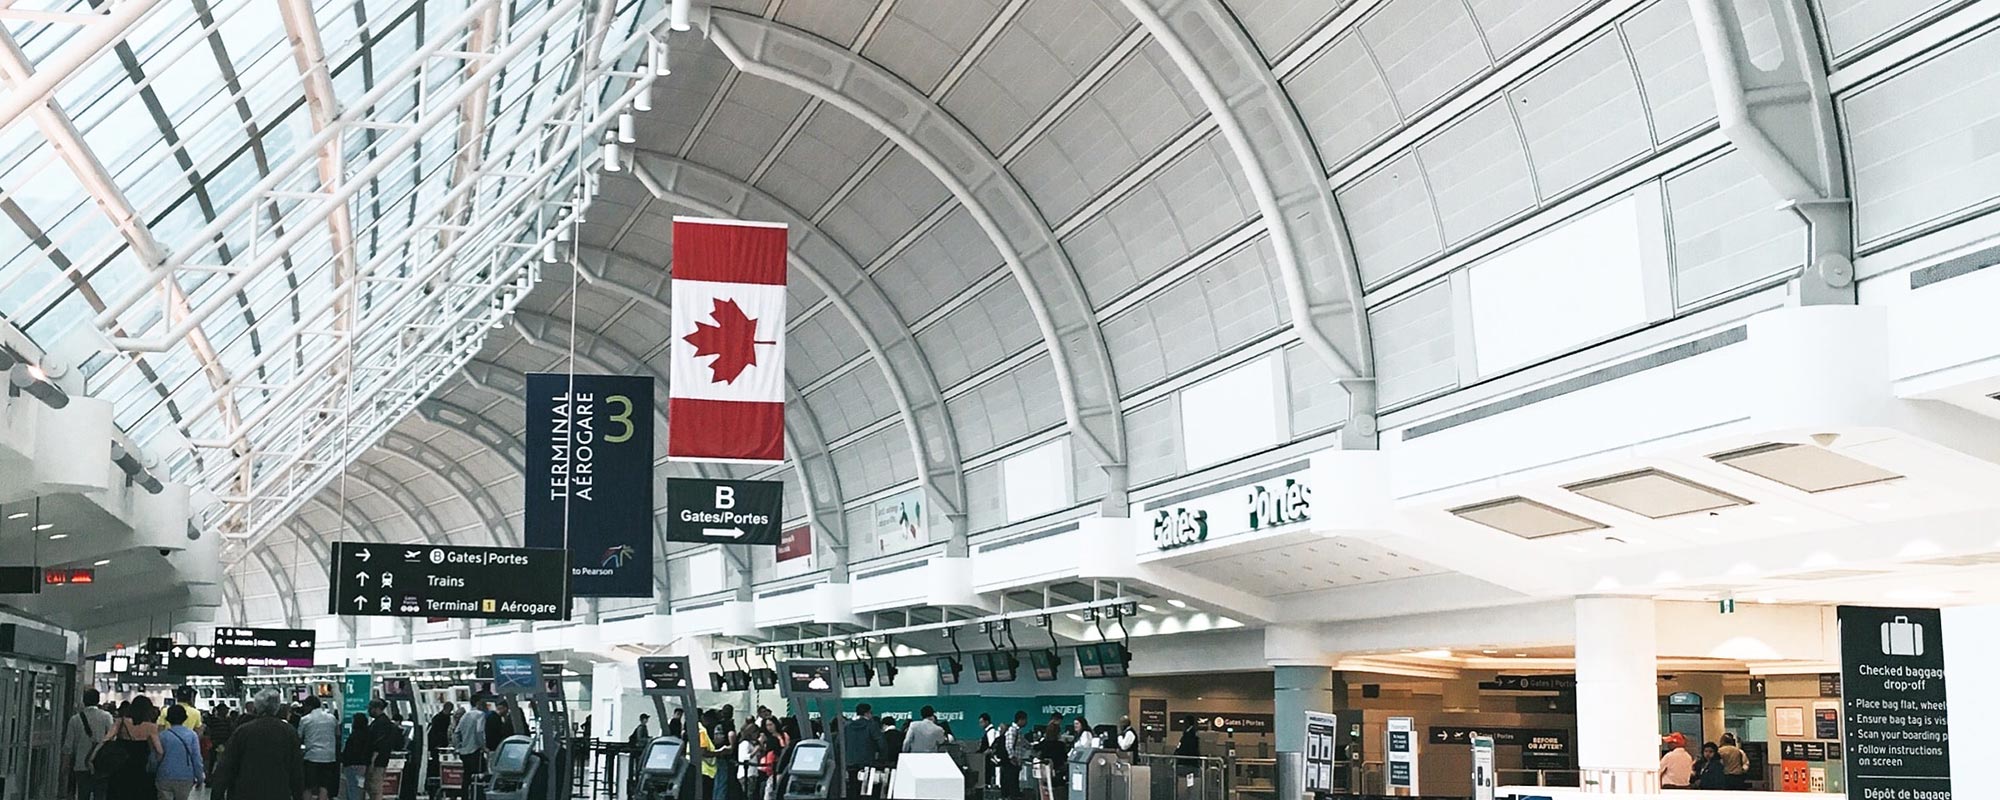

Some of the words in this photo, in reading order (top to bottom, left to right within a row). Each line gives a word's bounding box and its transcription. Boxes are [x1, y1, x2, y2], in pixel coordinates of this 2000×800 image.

[603, 394, 635, 443] 3
[551, 391, 569, 501] TERMINAL
[572, 392, 594, 501] AÉROGARE
[715, 485, 736, 510] B
[680, 509, 769, 525] Gates/Portes
[1153, 507, 1207, 551] Gates
[582, 567, 614, 576] Pearson
[427, 575, 465, 587] Trains
[426, 599, 478, 612] Terminal
[501, 601, 557, 615] Aérogare
[1859, 664, 1903, 676] Checked
[1905, 666, 1945, 679] baggag
[1884, 679, 1926, 692] drop-off
[1856, 698, 1880, 709] Place
[1882, 699, 1898, 711] bag
[1900, 699, 1918, 710] flat,
[1857, 714, 1887, 724] Ensure
[1889, 715, 1905, 726] bag
[1908, 716, 1922, 726] tag
[1924, 715, 1932, 725] is
[1857, 729, 1879, 739] Scan
[1881, 731, 1900, 740] your
[1902, 730, 1940, 742] boarding
[1858, 744, 1886, 754] Follow
[1888, 745, 1943, 755] instructions
[1859, 758, 1870, 766] on
[1872, 758, 1903, 766] screen
[1864, 787, 1895, 800] Dépôt
[1898, 789, 1911, 799] de
